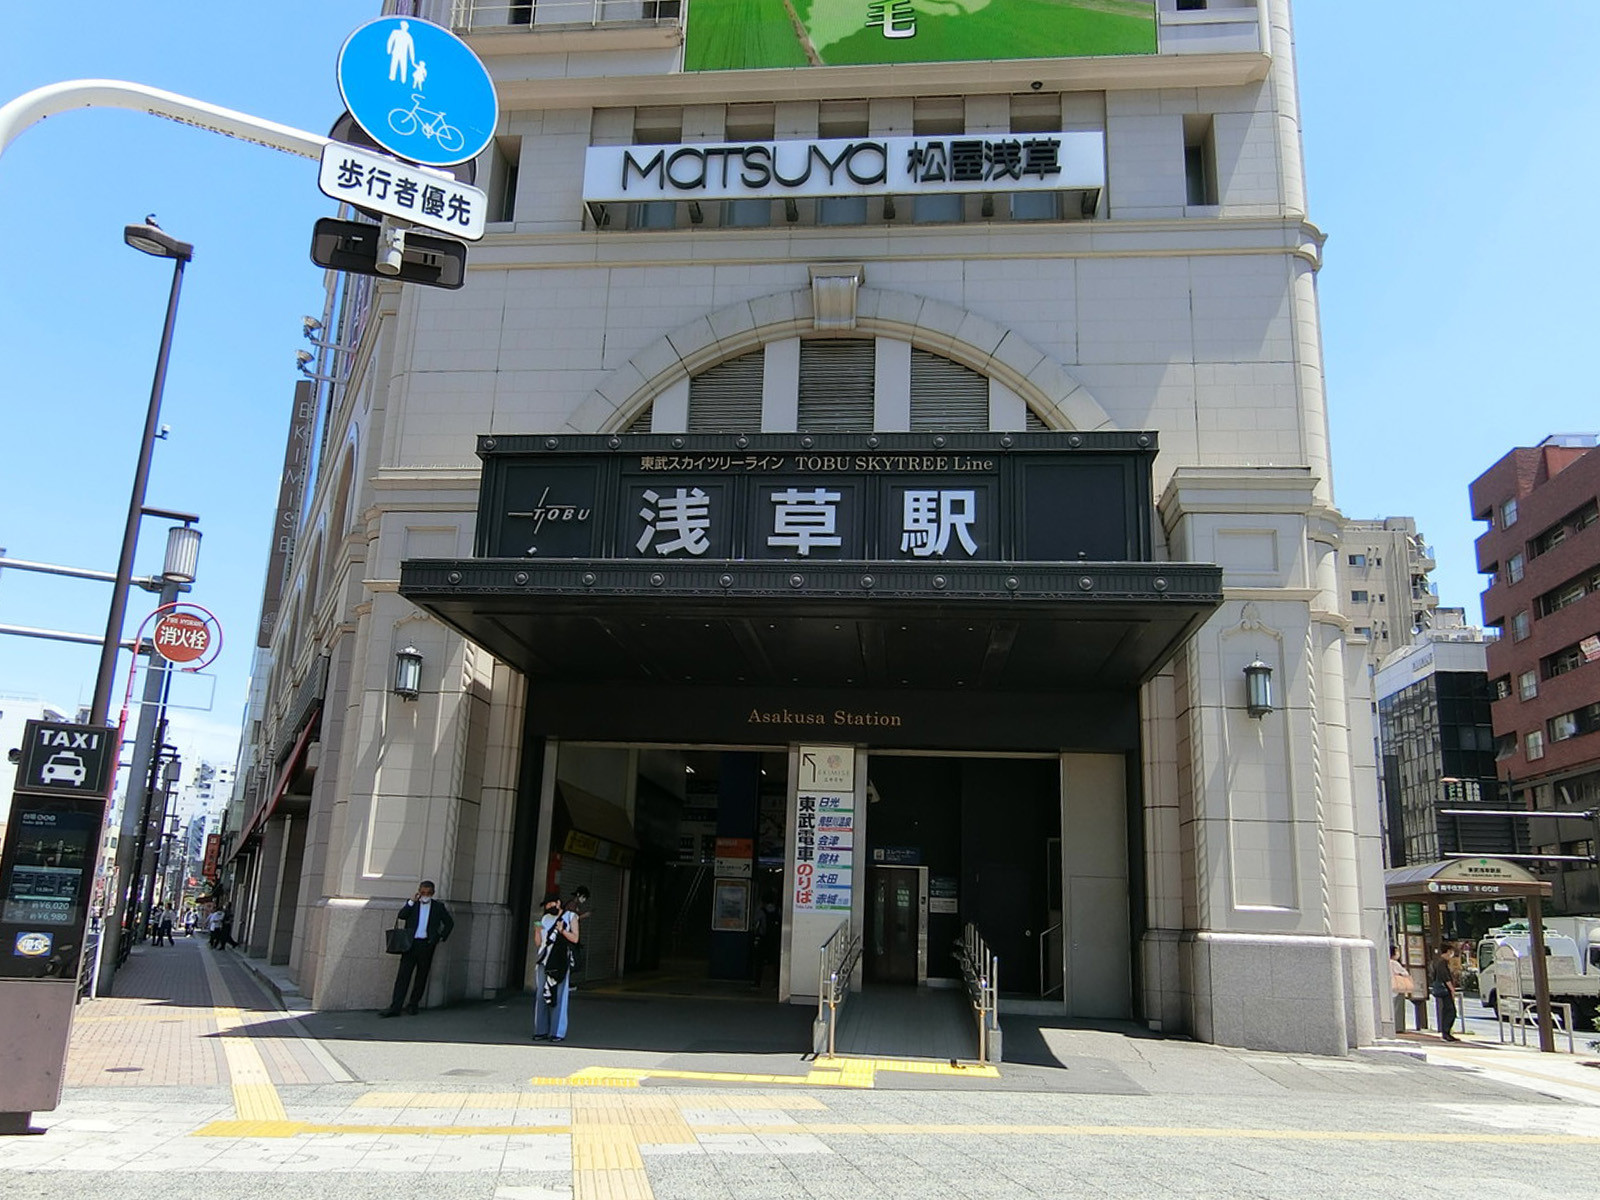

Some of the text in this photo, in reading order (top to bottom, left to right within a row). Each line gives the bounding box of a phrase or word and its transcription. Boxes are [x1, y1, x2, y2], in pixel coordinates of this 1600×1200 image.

[866, 0, 916, 38] 毛
[907, 137, 1062, 183] 松屋浅草
[338, 156, 472, 226] 歩行者優先
[640, 456, 993, 472] 東武スカイツリーライン TOBU SKYTREE Line
[636, 487, 978, 556] 浅草駅
[159, 626, 207, 650] 消火栓
[748, 709, 902, 726] Asakusa Station
[41, 730, 99, 749] TAXI
[819, 797, 840, 808] 日光
[818, 816, 852, 827] 鬼怒川温泉
[818, 835, 840, 846] 会津
[796, 796, 816, 904] 東武電車のりば
[818, 853, 840, 864] 館林
[816, 873, 838, 884] 太田
